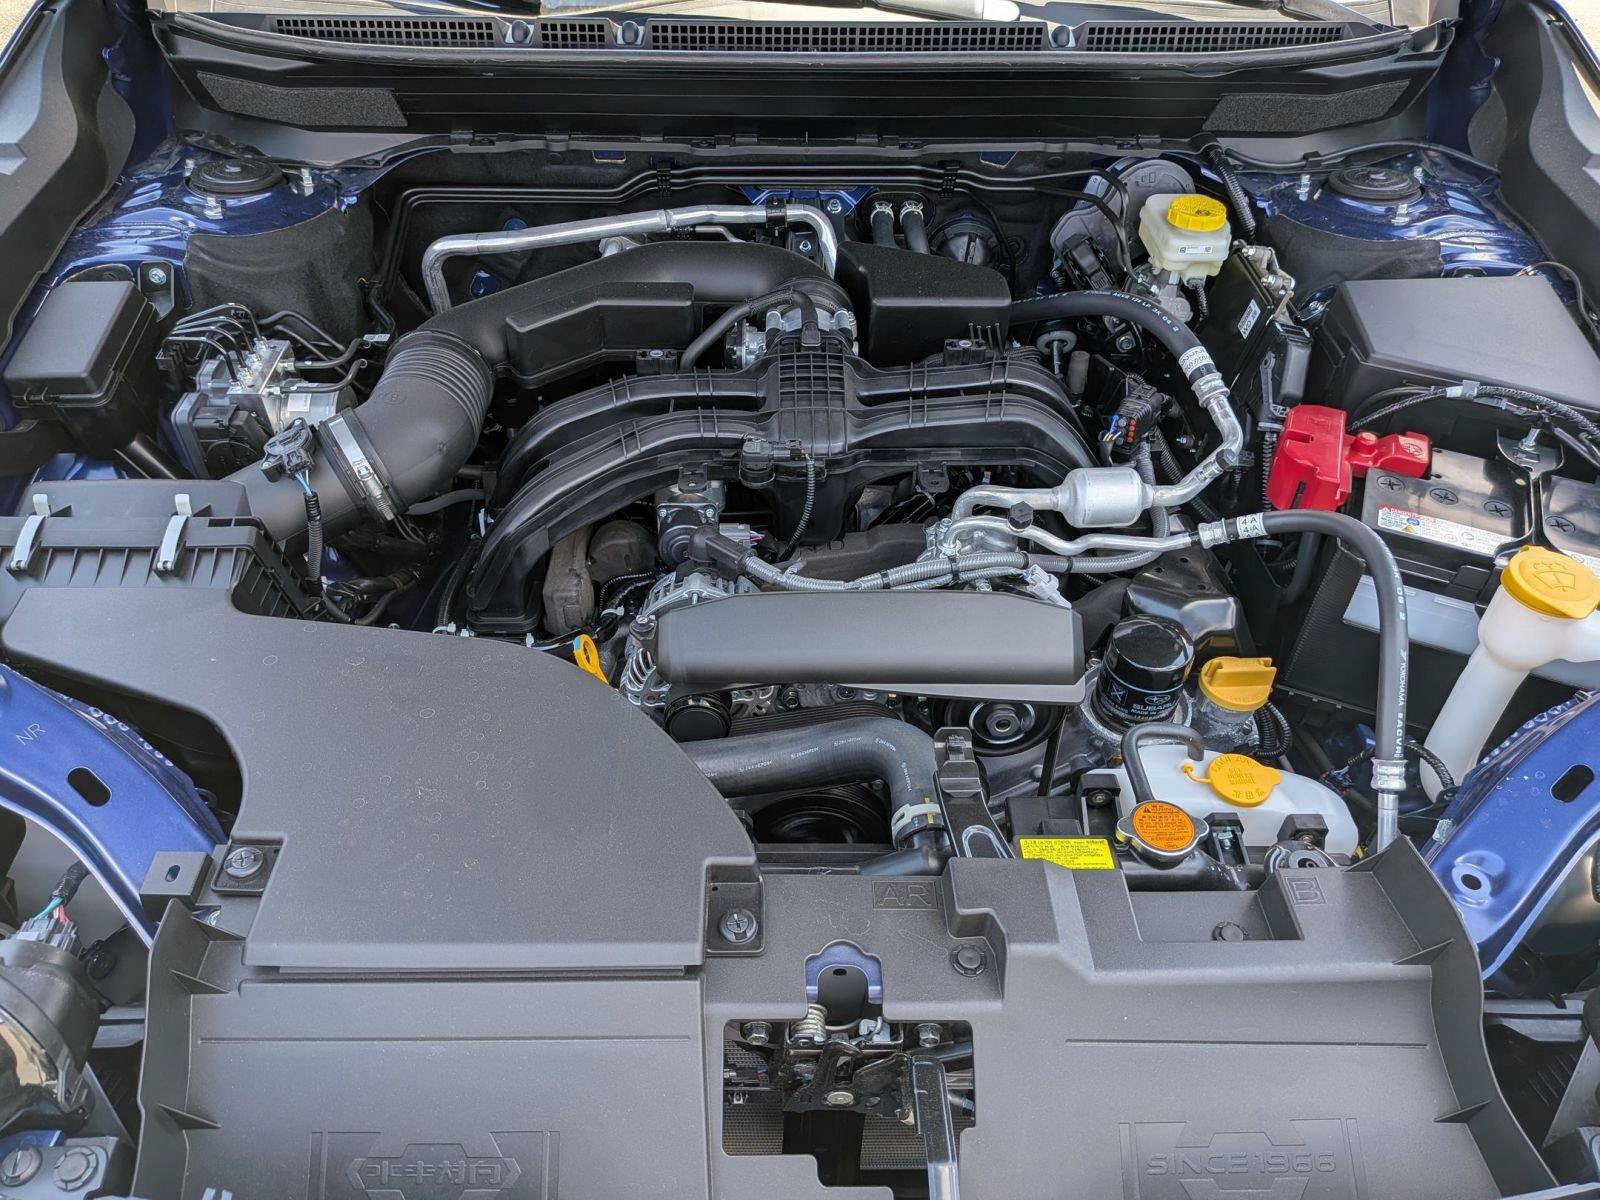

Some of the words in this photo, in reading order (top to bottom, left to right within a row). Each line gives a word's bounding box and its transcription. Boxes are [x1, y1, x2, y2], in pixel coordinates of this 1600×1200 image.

[1398, 662, 1408, 706] YOKOHAMA
[1132, 700, 1176, 711] SUBARU
[15, 723, 46, 746] NR
[878, 884, 932, 905] AR
[1292, 881, 1321, 902] B
[1147, 1152, 1249, 1176] SINCE
[1255, 1151, 1337, 1174] 1966
